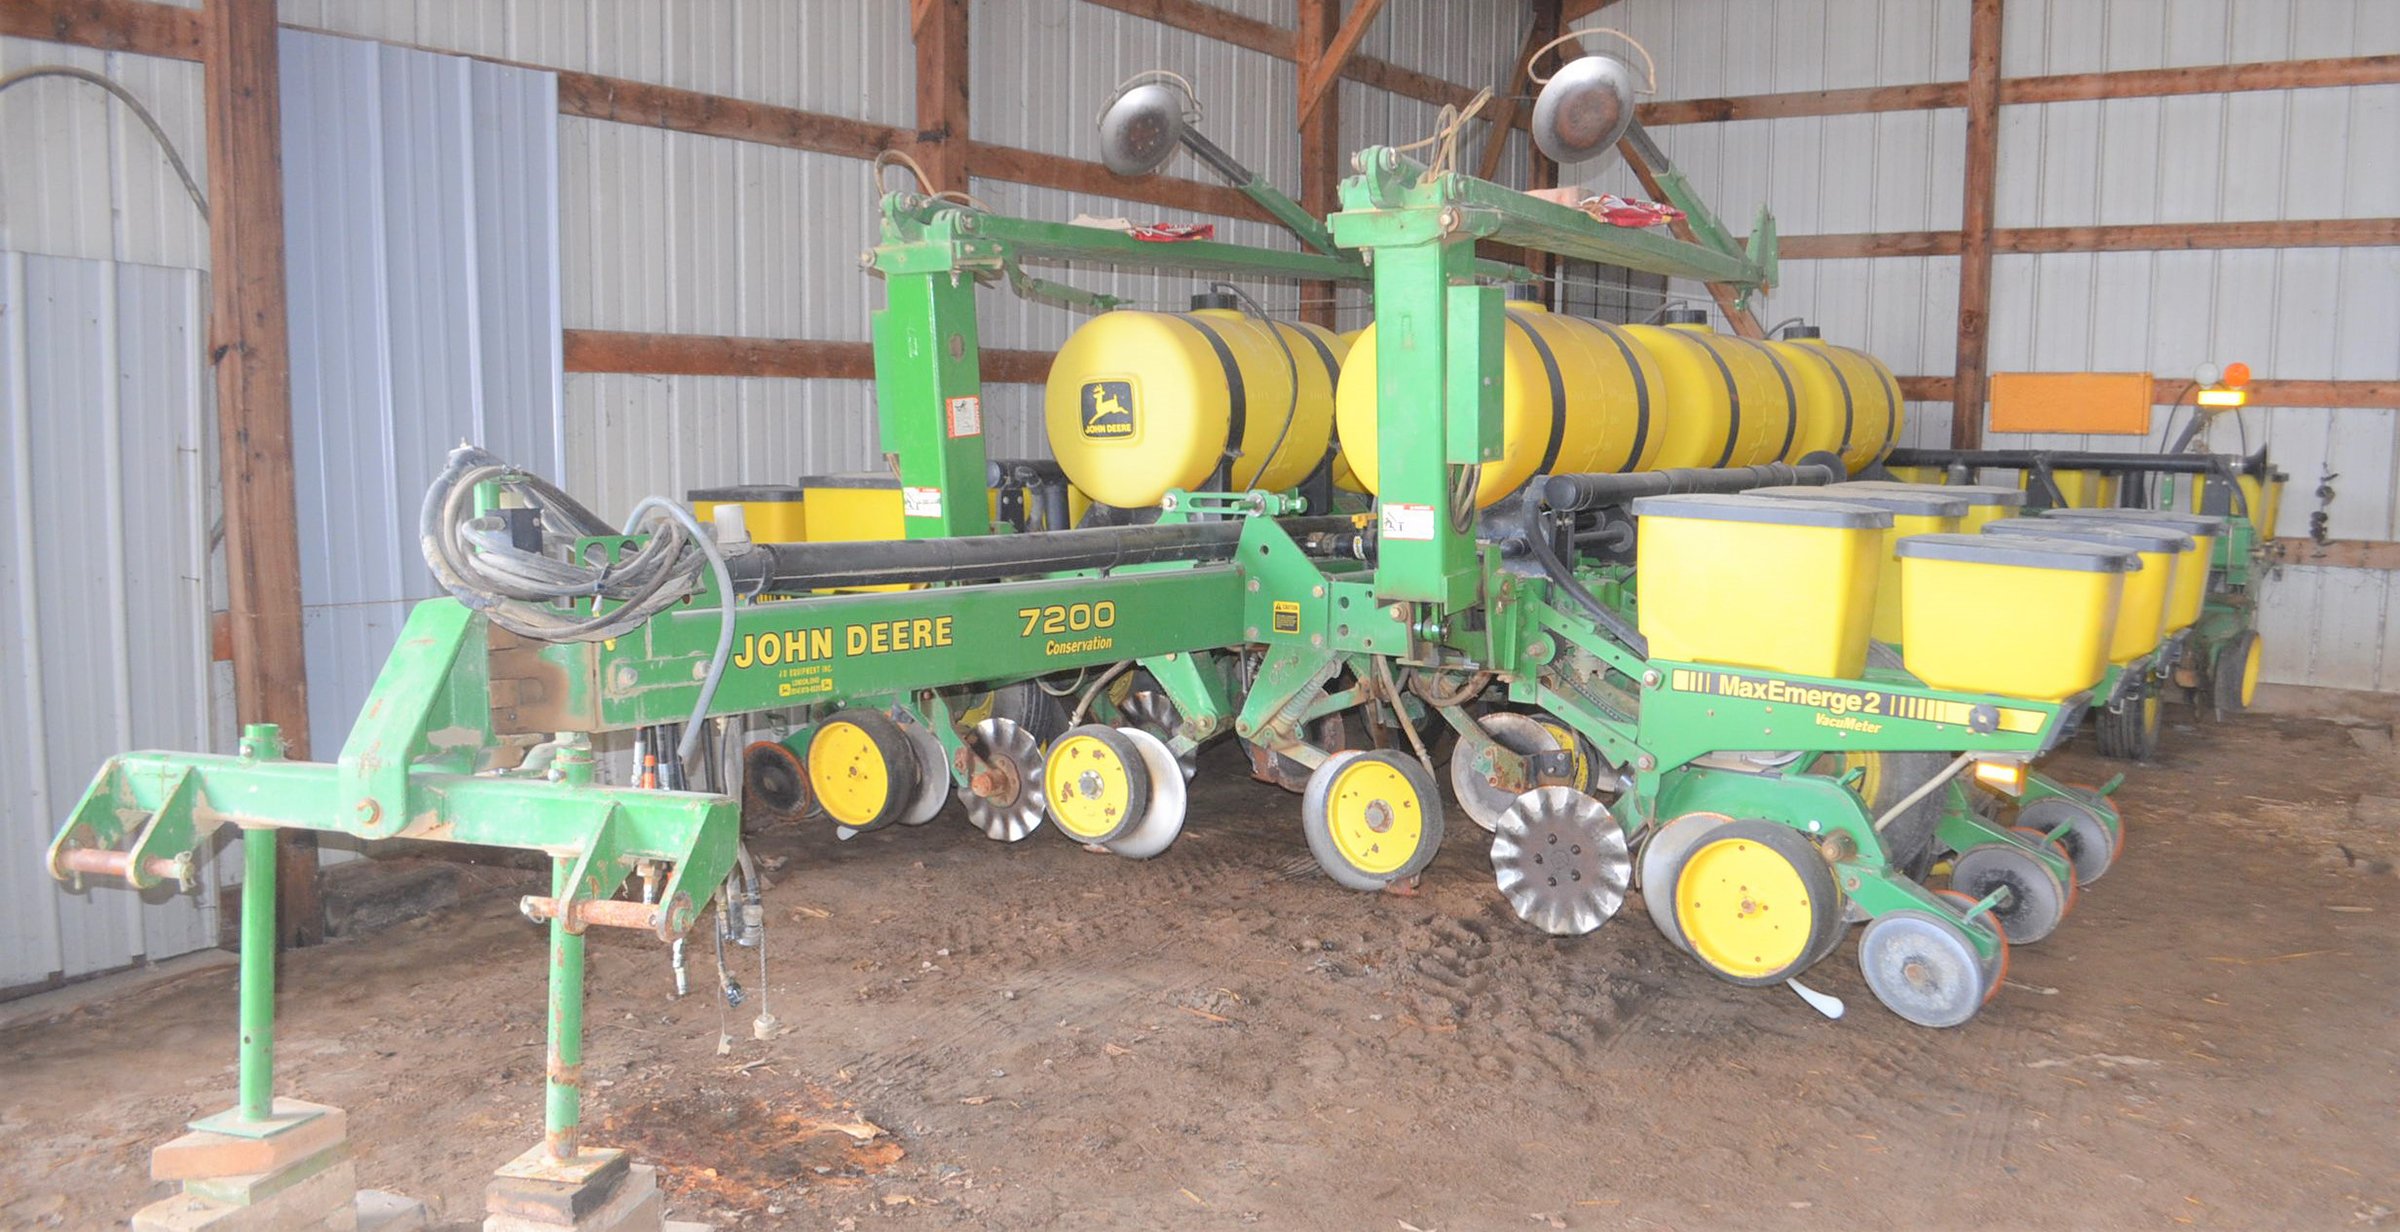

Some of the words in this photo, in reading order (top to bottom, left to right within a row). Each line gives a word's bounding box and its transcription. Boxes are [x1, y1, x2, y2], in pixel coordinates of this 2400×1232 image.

[1085, 424, 1106, 434] JOHN
[1106, 423, 1132, 433] DEERE
[1018, 600, 1117, 637] 7200
[733, 626, 834, 669] JOHN
[845, 615, 954, 657] DEERE
[1045, 636, 1113, 657] Conservation
[1815, 712, 1883, 734] VacuMeter
